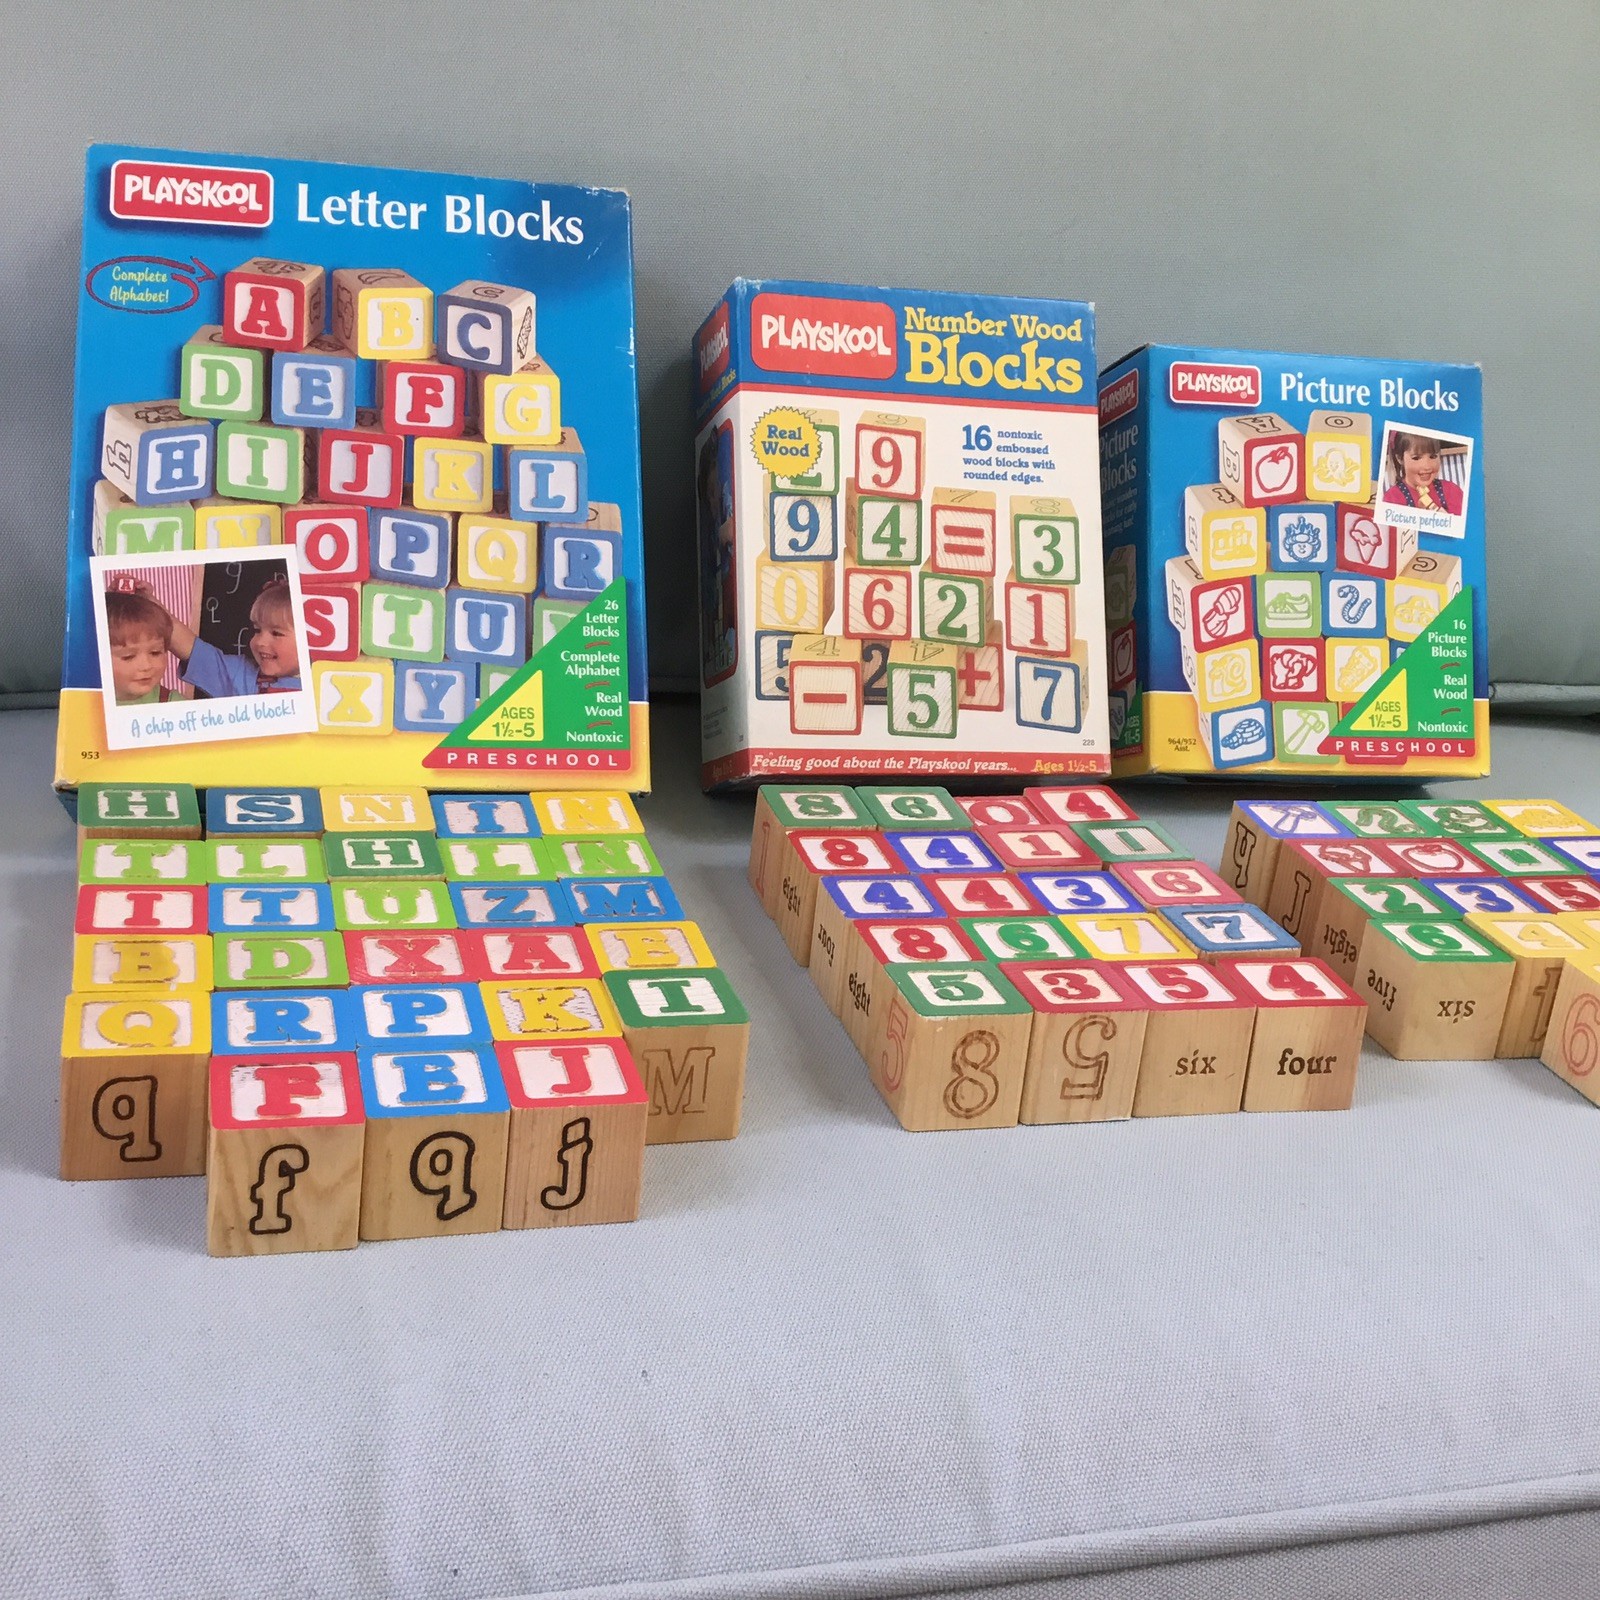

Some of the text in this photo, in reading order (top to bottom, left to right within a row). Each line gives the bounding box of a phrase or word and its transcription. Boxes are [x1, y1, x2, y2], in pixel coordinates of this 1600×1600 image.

[124, 173, 263, 212] PLAYSKOOL
[297, 182, 585, 246] Letter Blocks
[112, 265, 168, 283] Complete
[109, 282, 170, 304] Alphabet!
[240, 286, 493, 360] A B C
[761, 313, 892, 357] PLAYSKOOL
[904, 306, 1082, 342] Number Wood
[904, 331, 1084, 394] Blocks
[199, 358, 542, 433] D E F G
[1176, 370, 1256, 396] PLAYSKOOL
[1280, 373, 1460, 412] Picture Blocks
[766, 424, 802, 441] Real
[962, 424, 1044, 452] 16 nontoxic
[761, 441, 810, 457] Wood
[872, 436, 903, 488] 9
[962, 456, 1056, 470] wood blocks with
[996, 443, 1050, 455] embossed
[155, 438, 567, 508] H I J K L
[963, 470, 1045, 485] rounded edges.
[1385, 508, 1453, 530] Picture perfect!
[787, 499, 1064, 577] 9 4 3
[305, 521, 607, 590] O P Q R
[586, 612, 620, 624] Letter
[604, 599, 619, 611] 26
[862, 577, 1049, 648] 6 2 1
[303, 594, 508, 652] S T U
[582, 626, 620, 638] Blocks
[1453, 619, 1467, 630] 16
[1427, 632, 1468, 644] Picture
[1431, 646, 1468, 658] Blocks
[560, 650, 621, 666] Complete
[565, 665, 621, 679] Alphabet
[1433, 688, 1468, 700] Wood
[1444, 674, 1468, 686] Real
[329, 671, 457, 723] X Y
[584, 706, 623, 717] Wood
[596, 692, 622, 703] Real
[907, 666, 1063, 729] 5 7
[1374, 701, 1401, 713] AGES
[131, 699, 296, 738] A chip off the old block!
[500, 707, 535, 720] AGES
[1417, 721, 1469, 733] Nontoxic
[566, 731, 624, 743] Nontoxic
[1082, 739, 1096, 747] 228
[1335, 740, 1466, 754] PRESCHOOL
[81, 751, 100, 760] 953
[446, 752, 618, 767] PRESCHOOL
[752, 754, 1018, 773] Feeling good about the Playskool years...
[1033, 759, 1065, 774] Ages
[103, 791, 505, 834] H S N I
[795, 791, 1112, 820] 8 6 4
[112, 840, 420, 878] T L H
[820, 834, 1063, 868] 8 4 1
[124, 883, 660, 927] I T U Z M
[862, 871, 1204, 911] 4 4 3 6
[1455, 884, 1515, 913] 3
[892, 914, 1246, 962] 8 7 7
[110, 930, 681, 984] B D X A E
[848, 971, 871, 1018] eight
[926, 965, 1327, 1002] 5 3 5 4
[97, 980, 705, 1048] Q R P K I
[1437, 1000, 1476, 1024] six
[1562, 992, 1600, 1077] 6
[943, 1029, 1001, 1121] 8
[1174, 1047, 1338, 1076] six four
[254, 1047, 593, 1118] F E J
[250, 1143, 310, 1236] f
[540, 1117, 593, 1212] j
